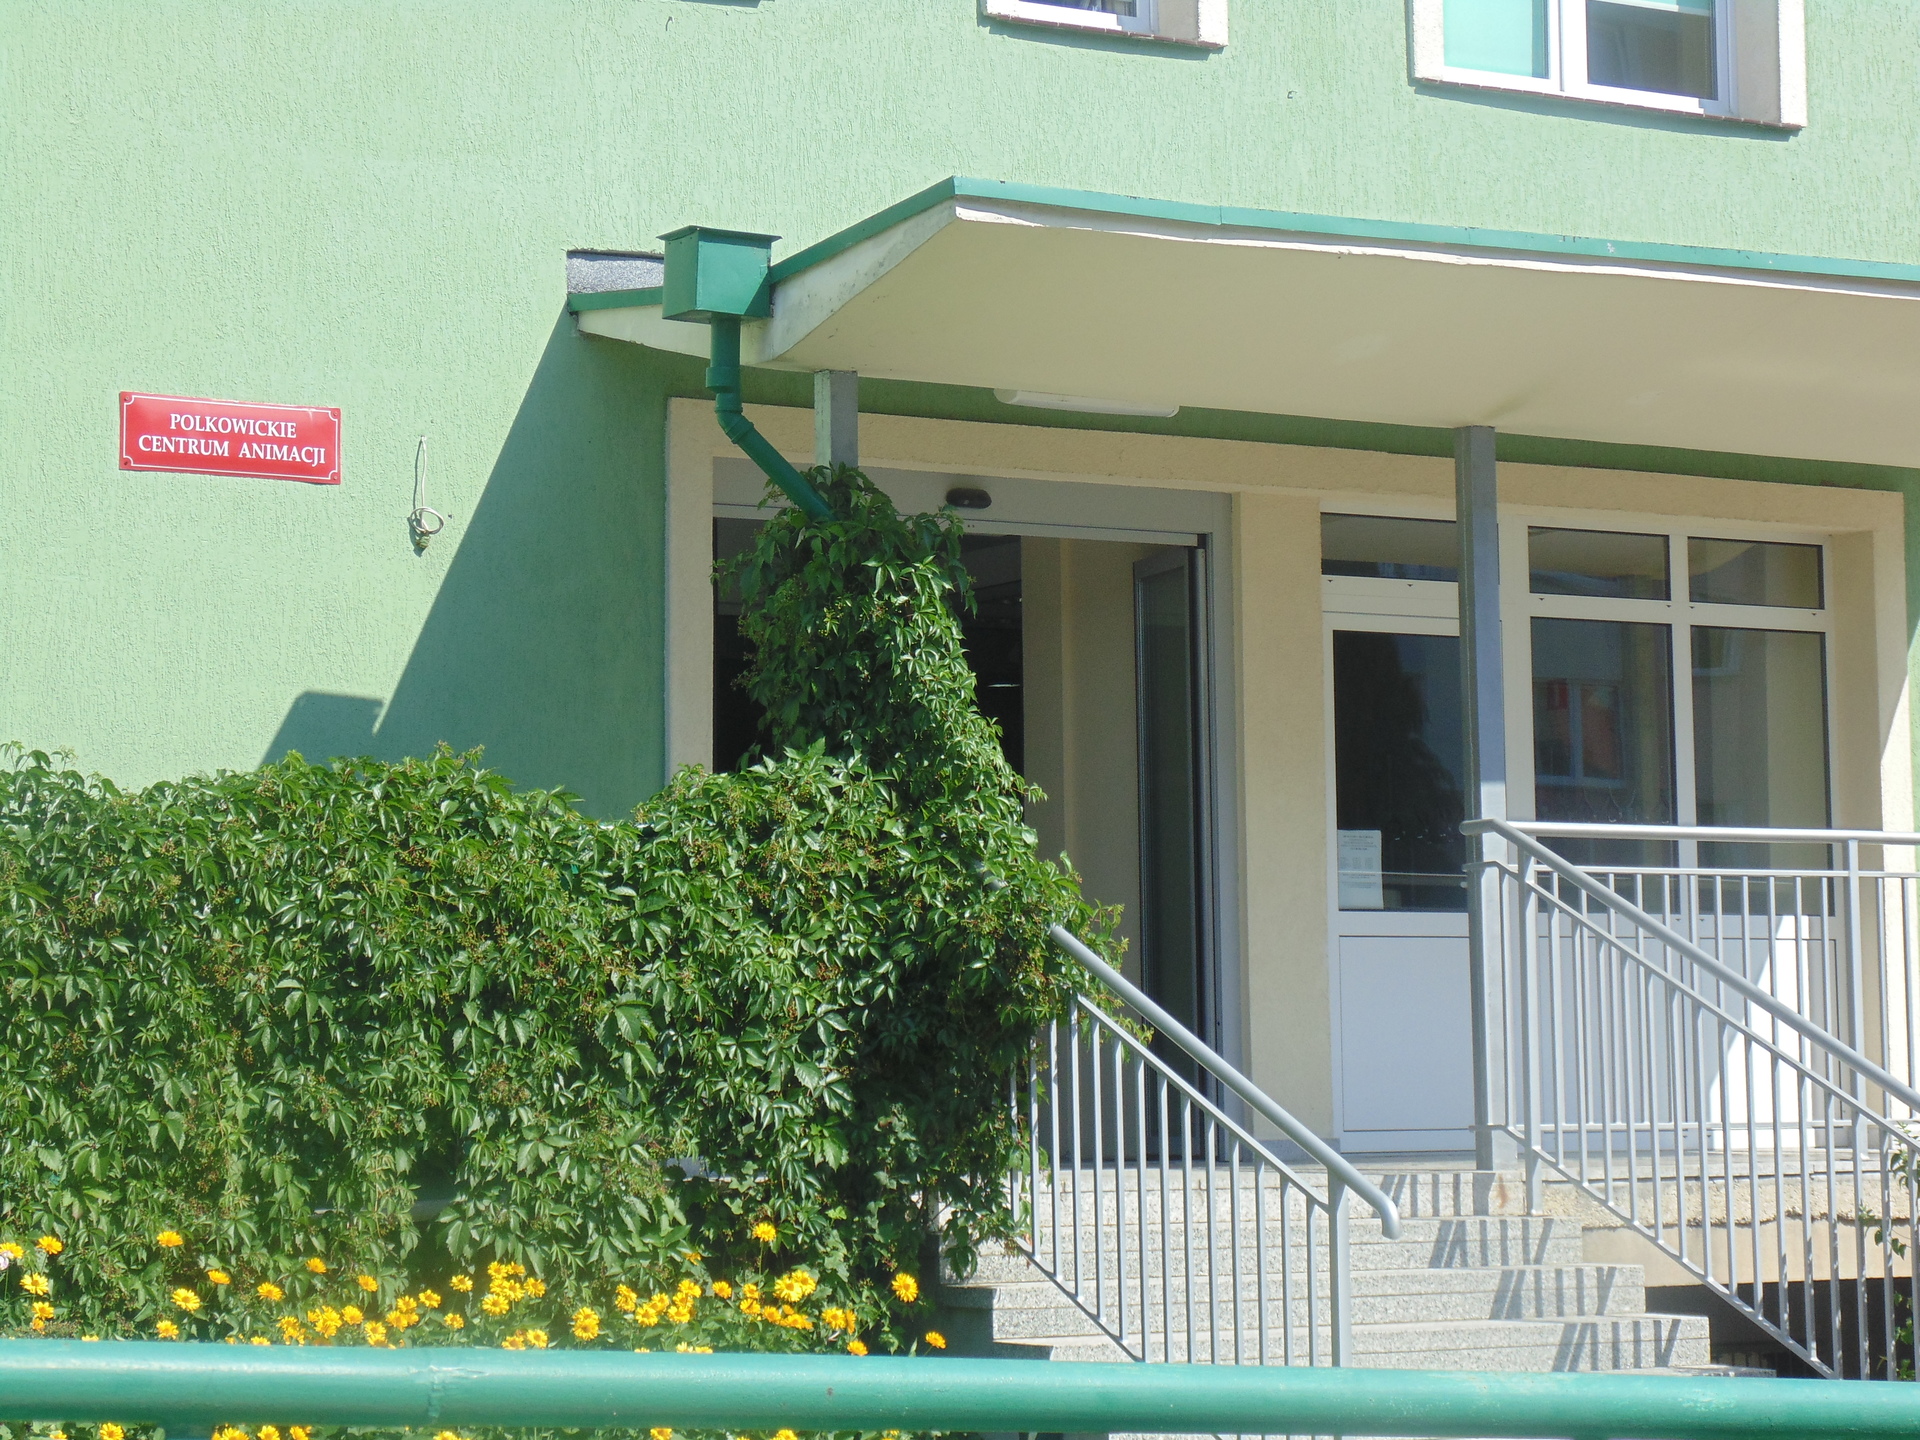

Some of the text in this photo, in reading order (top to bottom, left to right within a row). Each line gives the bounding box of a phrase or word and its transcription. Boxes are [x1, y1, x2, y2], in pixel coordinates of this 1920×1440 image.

[170, 413, 297, 438] POLKOWICKIE
[138, 434, 326, 467] CENTRUM ANIMACJI
